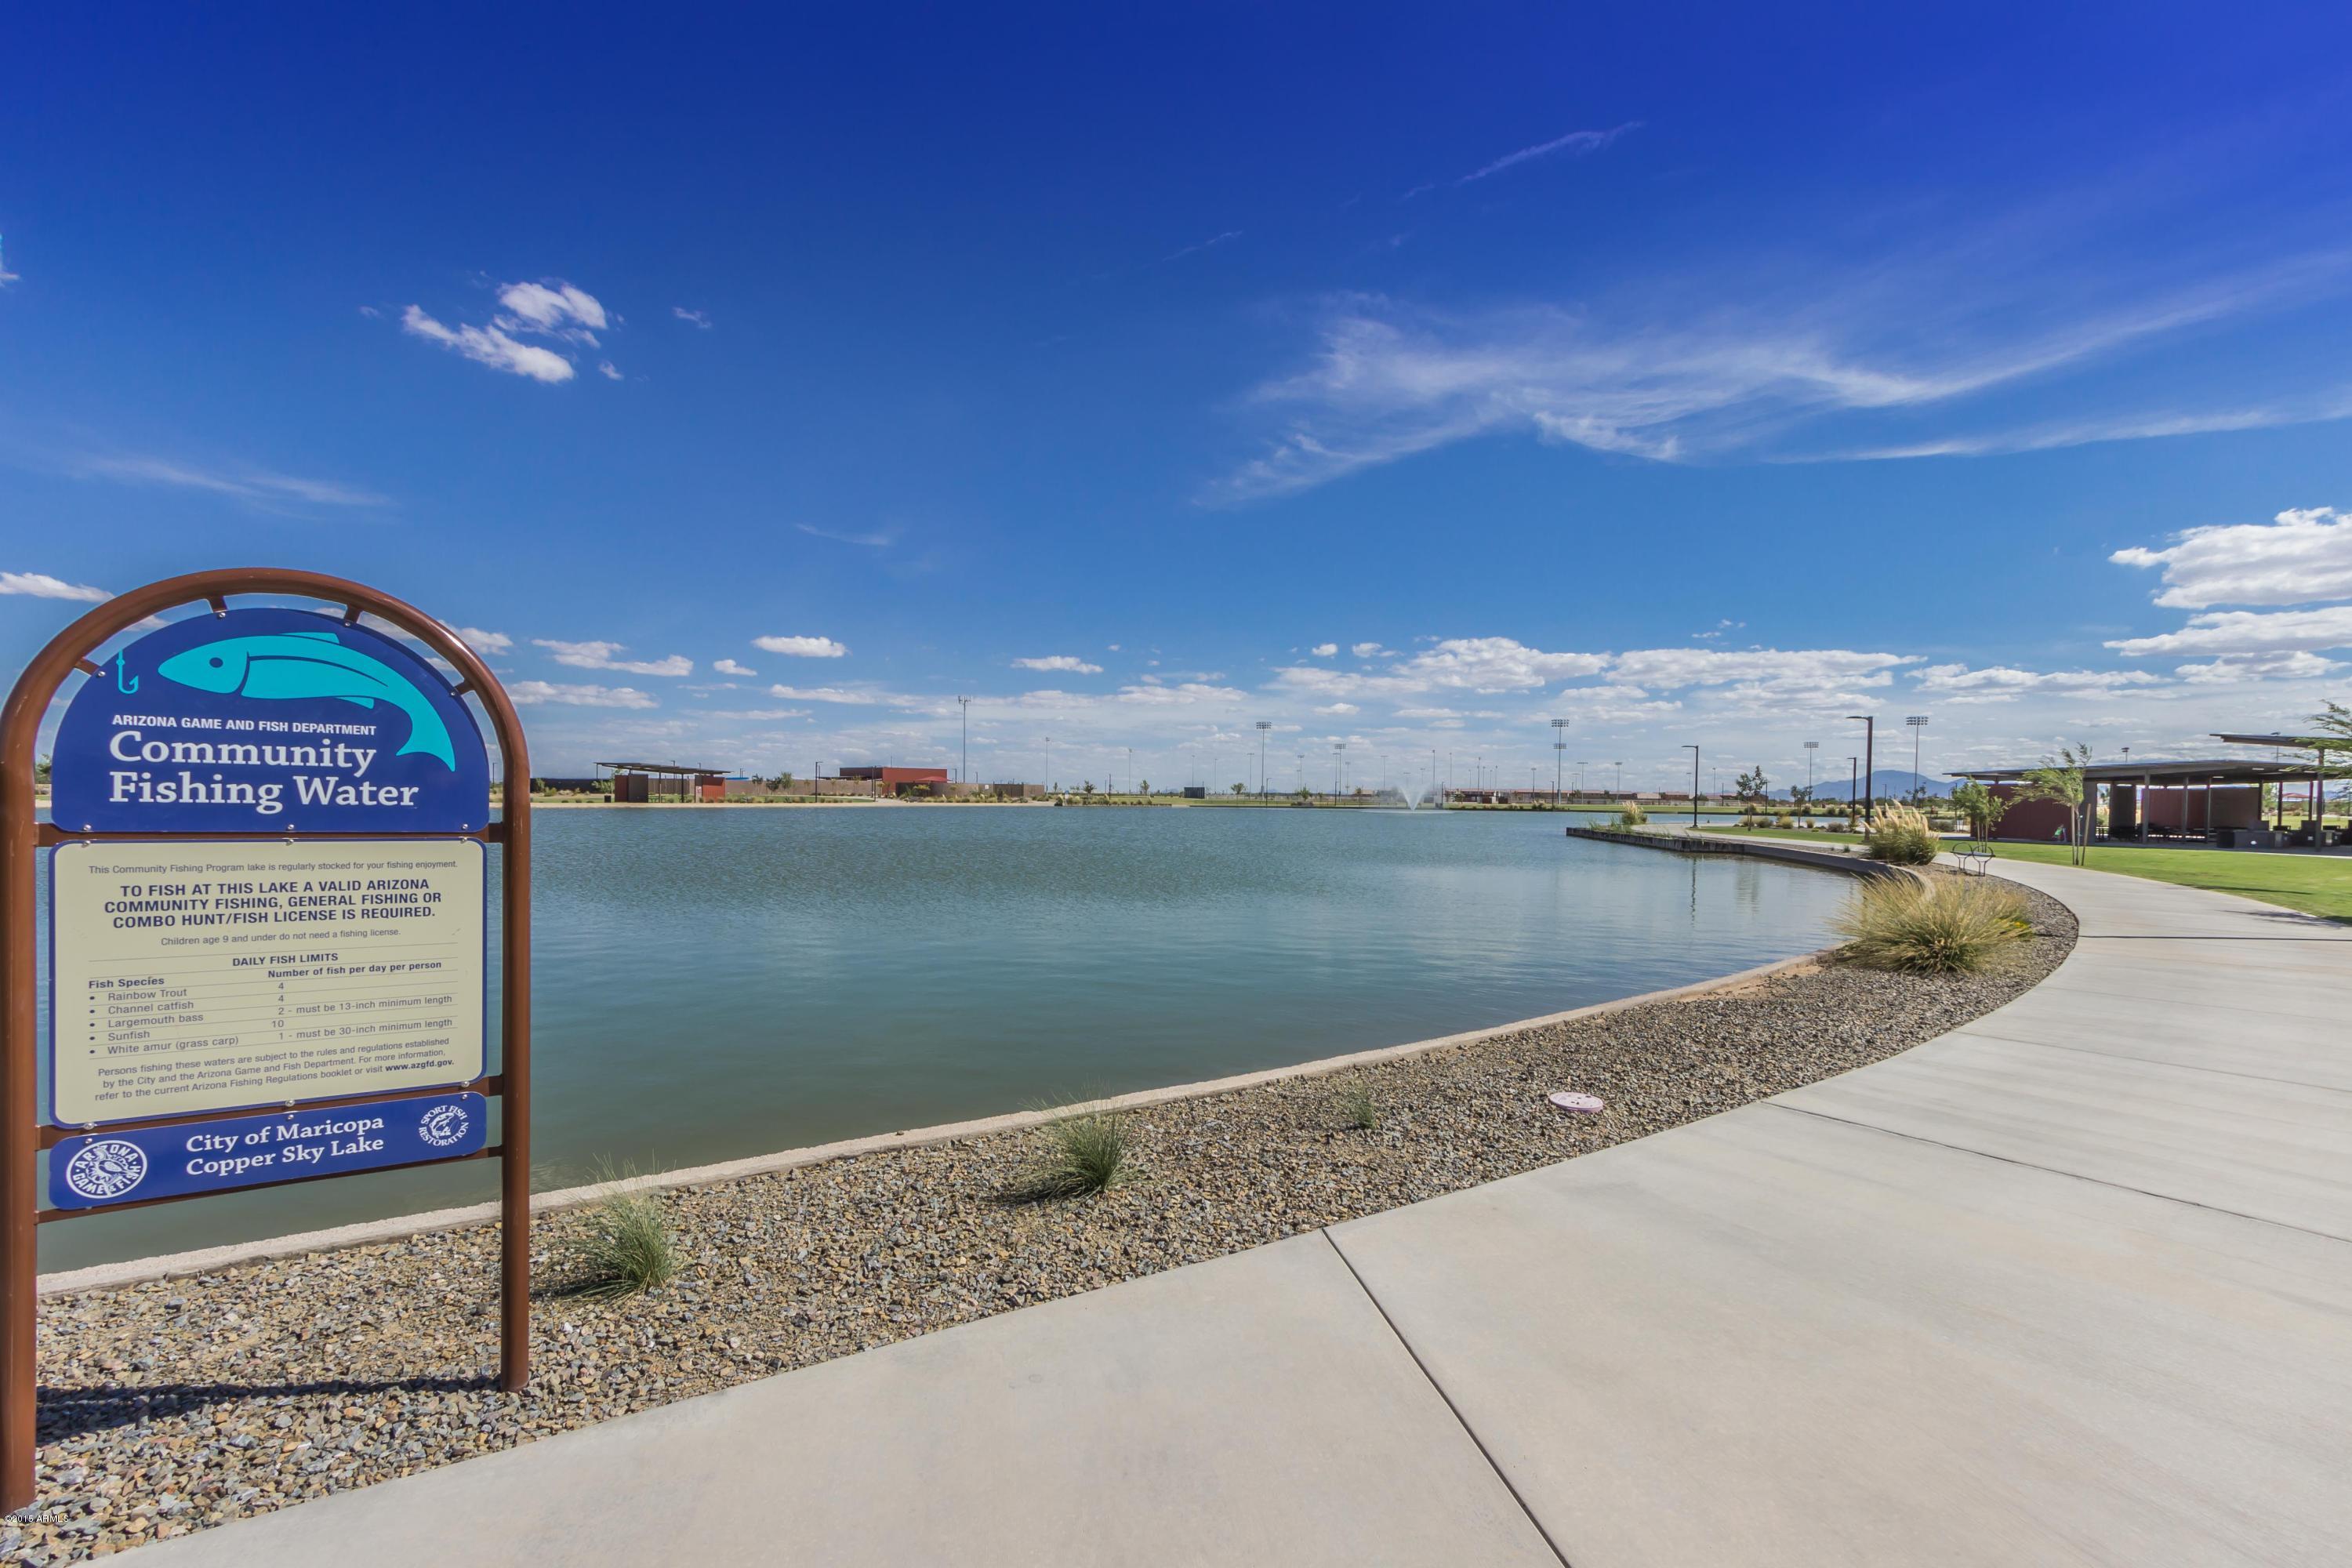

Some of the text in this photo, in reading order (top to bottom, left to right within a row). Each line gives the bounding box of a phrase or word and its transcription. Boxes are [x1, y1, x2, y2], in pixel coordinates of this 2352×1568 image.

[112, 715, 376, 735] ARIZONA GAME AND FISH DEPARTMENT
[110, 730, 376, 776] Community
[110, 771, 419, 813] Fishing Water
[113, 865, 167, 874] Community
[170, 864, 203, 873] Fishing
[206, 864, 244, 873] Program
[387, 861, 412, 869] fishing
[416, 861, 458, 869] enjoyment.
[121, 879, 429, 896] TO FISH AT THIS LAKE A VALID ARIZONA
[104, 892, 441, 913] COMMUNITY FISHING, GENERAL FISHING OR
[113, 906, 435, 928] COMBO HUNT/FISH LICENSE IS REQUIRED.
[162, 937, 200, 946] Children
[203, 936, 220, 945] age
[340, 930, 368, 938] fishing
[233, 953, 338, 966] DAILY FISH LIMITS
[268, 969, 309, 978] Number
[327, 966, 345, 975] fish
[350, 966, 365, 975] per
[369, 964, 386, 974] day
[390, 964, 405, 973] per
[409, 961, 441, 971] person
[89, 977, 165, 989] Fish Species
[108, 989, 187, 1001] Rainbow Trout
[339, 1001, 376, 1011] 13-inch
[379, 998, 421, 1007] minimum
[425, 996, 452, 1004] length
[108, 1001, 194, 1014] Channel catfish
[108, 1014, 203, 1029] Largemouth bass
[339, 1025, 376, 1035] 30-inch
[379, 1022, 422, 1031] minimum
[425, 1019, 452, 1029] length
[108, 1031, 150, 1041] Sunfish
[108, 1036, 238, 1054] White amur (grass carp)
[98, 1066, 137, 1076] Persons
[141, 1064, 172, 1073] fishing
[255, 1052, 287, 1062] subject
[358, 1043, 402, 1054] regulations
[405, 1038, 449, 1048] established
[137, 1076, 155, 1086] City
[158, 1074, 176, 1083] and
[180, 1072, 194, 1080] the
[197, 1069, 231, 1078] Arizona
[235, 1066, 261, 1075] Game
[304, 1057, 356, 1069] Department.
[398, 1049, 445, 1059] information,
[95, 1091, 118, 1101] refer
[154, 1085, 189, 1095] current
[192, 1082, 227, 1091] Arizona
[230, 1078, 263, 1088] Fishing
[267, 1072, 318, 1083] Regulations
[321, 1068, 352, 1078] booklet
[386, 1059, 454, 1072] www.azgfd.gov.
[421, 1105, 467, 1124] SPORT FISH
[187, 1118, 383, 1152] City of Maricopa
[419, 1122, 469, 1146] RESTORATION
[74, 1144, 138, 1169] ARZONA
[187, 1138, 383, 1176] Copper Sky Lake
[73, 1174, 104, 1194] GAME
[116, 1165, 141, 1189] FISH
